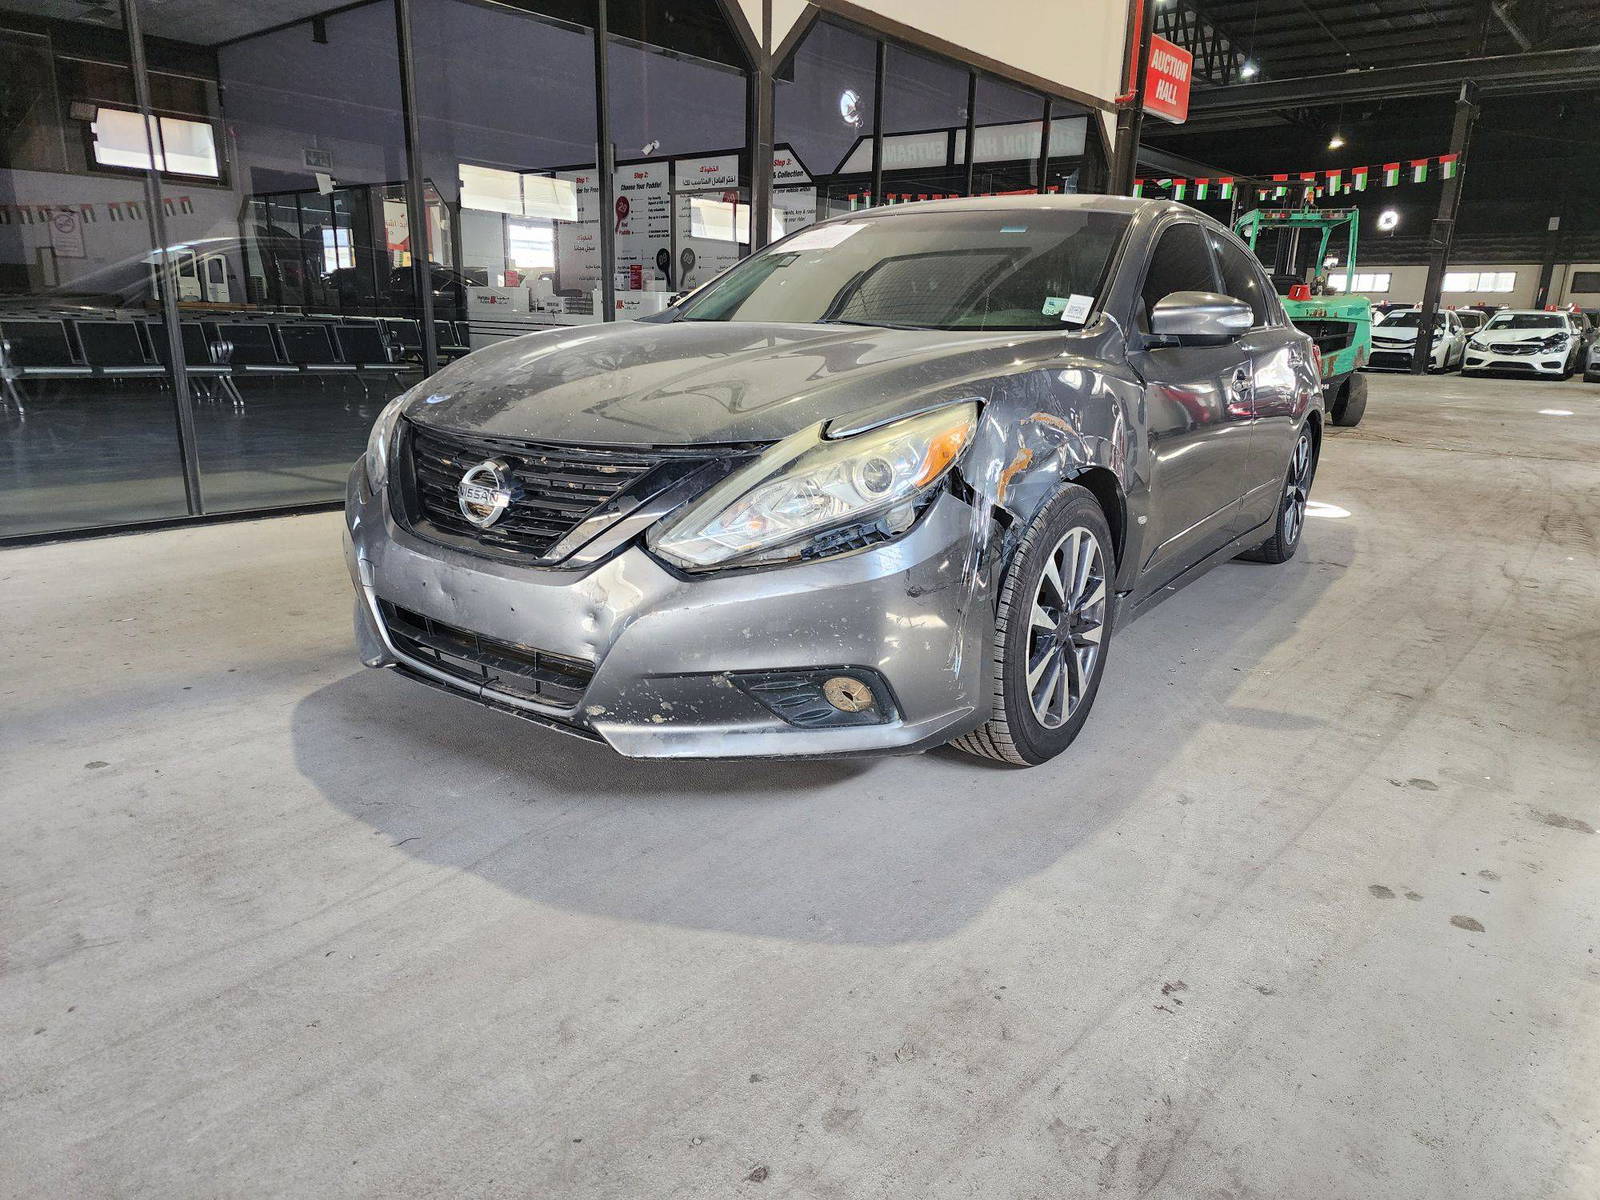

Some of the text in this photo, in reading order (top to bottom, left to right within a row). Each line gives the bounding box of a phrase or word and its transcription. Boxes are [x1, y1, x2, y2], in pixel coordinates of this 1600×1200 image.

[1151, 49, 1188, 82] AUCTION
[1156, 79, 1177, 105] HALL
[773, 159, 785, 167] Step
[777, 169, 804, 179] Collection
[459, 486, 499, 503] NISSAN
